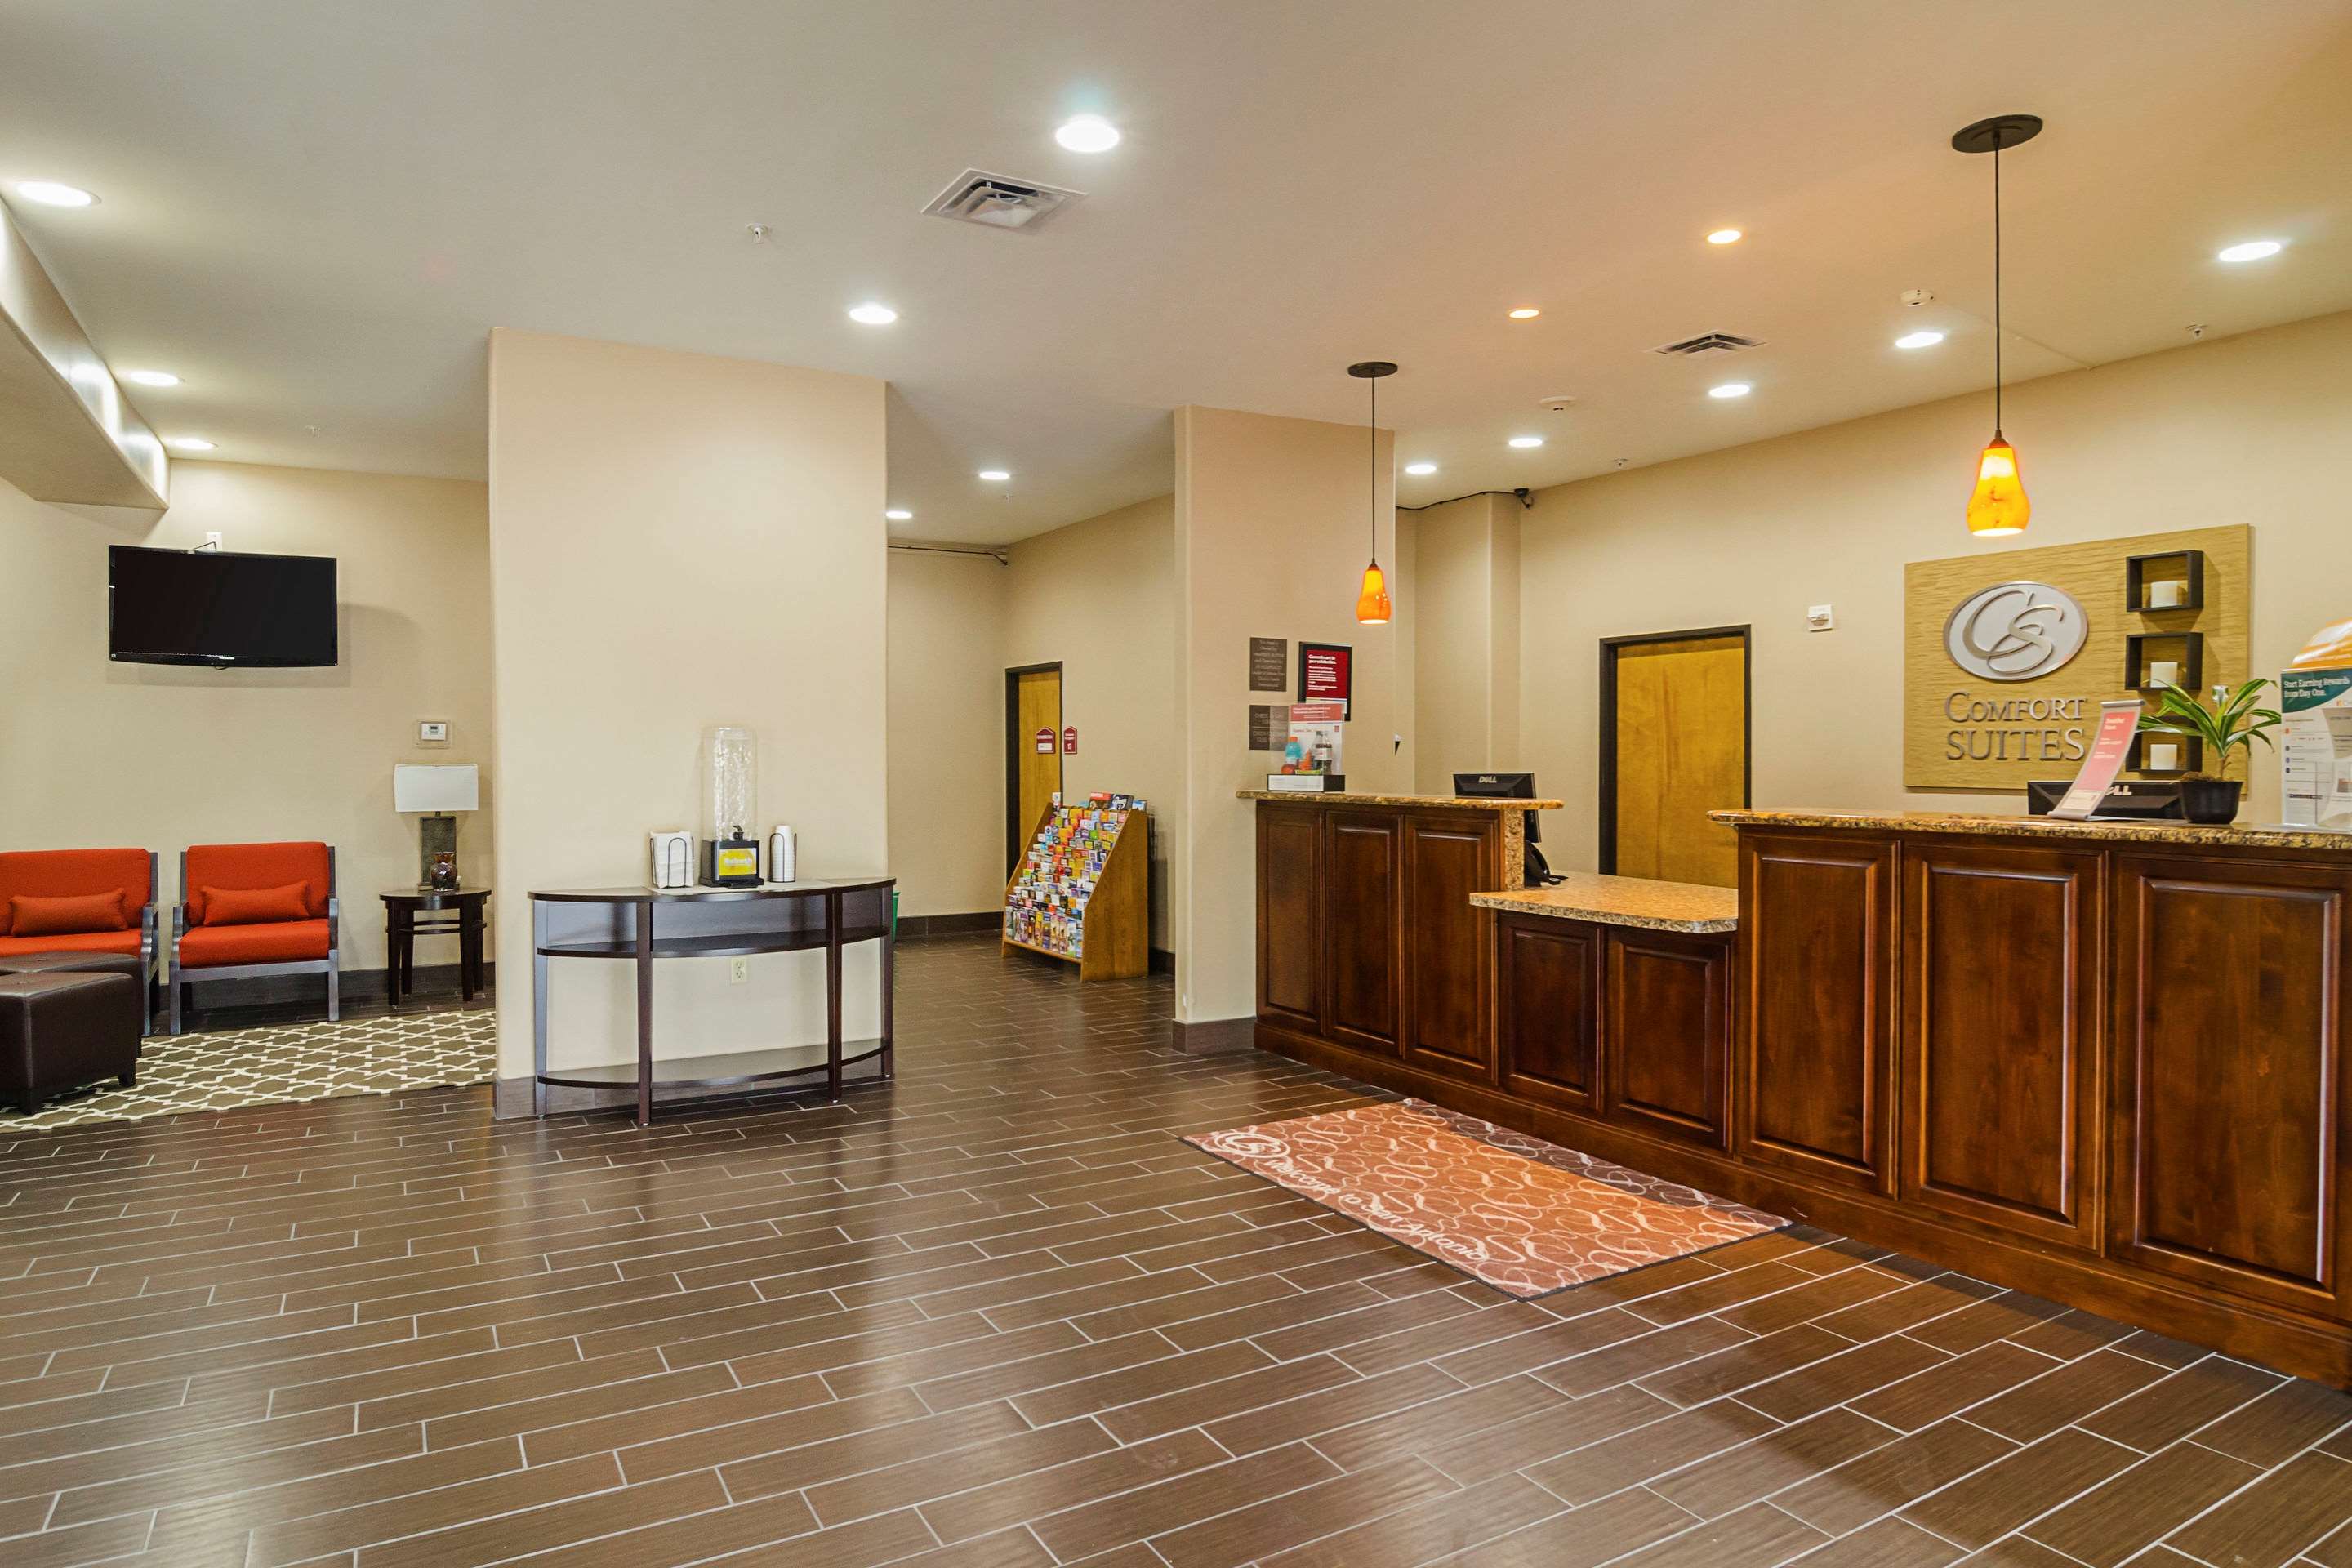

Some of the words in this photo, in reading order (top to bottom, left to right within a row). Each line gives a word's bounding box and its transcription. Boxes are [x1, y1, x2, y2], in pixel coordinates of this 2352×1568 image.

[1946, 728, 2085, 760] SUITES
[1264, 1160, 1341, 1195] Welcome
[1339, 1193, 1363, 1205] to
[1361, 1204, 1403, 1223] San
[1400, 1223, 1488, 1262] Antonio
